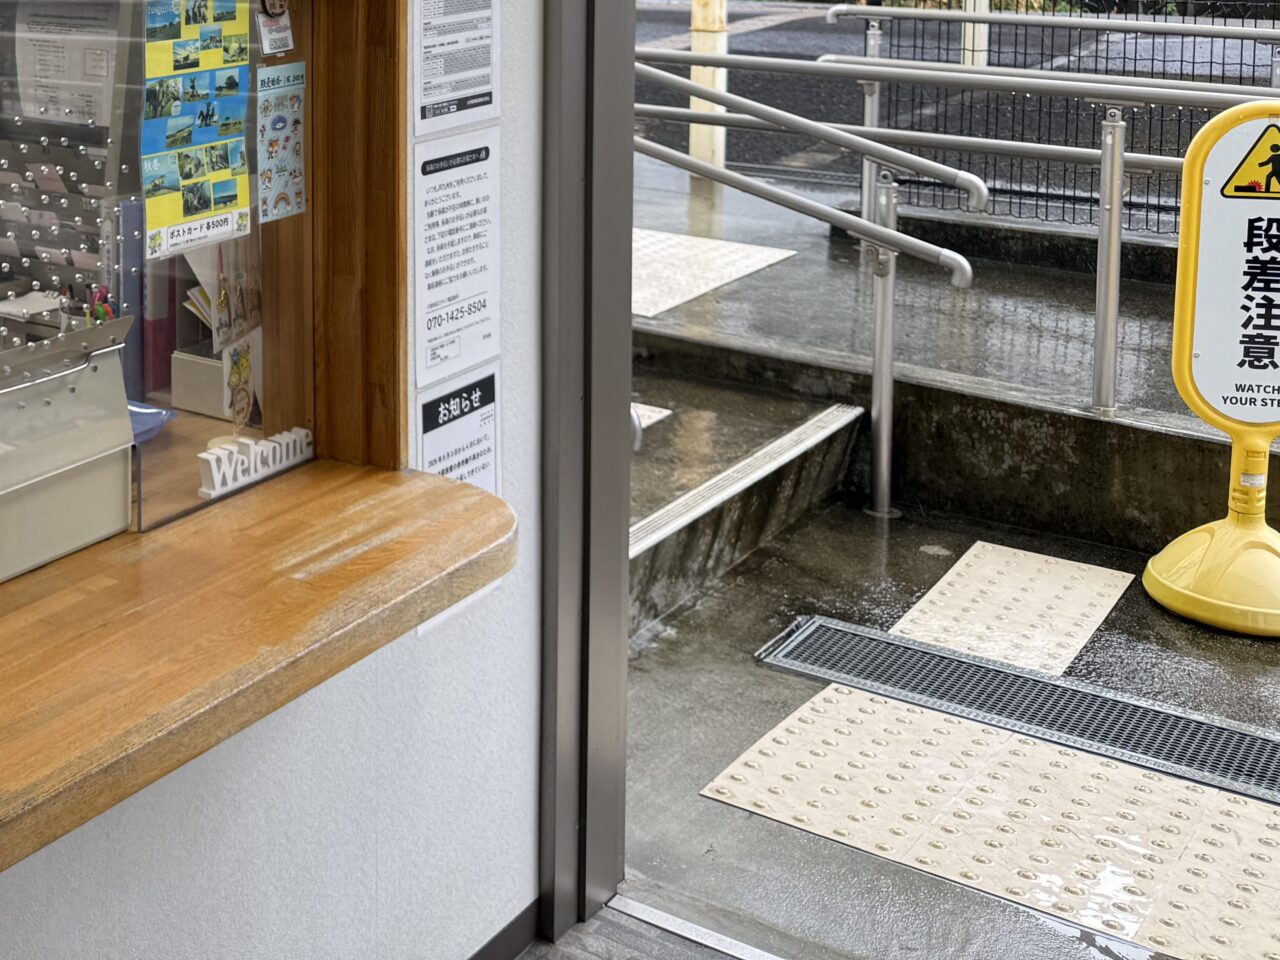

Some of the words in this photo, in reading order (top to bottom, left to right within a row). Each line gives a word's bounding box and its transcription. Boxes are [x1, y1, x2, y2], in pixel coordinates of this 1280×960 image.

[1237, 216, 1280, 371] 段差注意
[426, 299, 487, 332] 070-1425-8504
[438, 387, 482, 425] お知らせ
[1221, 395, 1257, 407] YOUR
[1234, 383, 1280, 395] WATCH
[197, 426, 315, 500] Welcome
